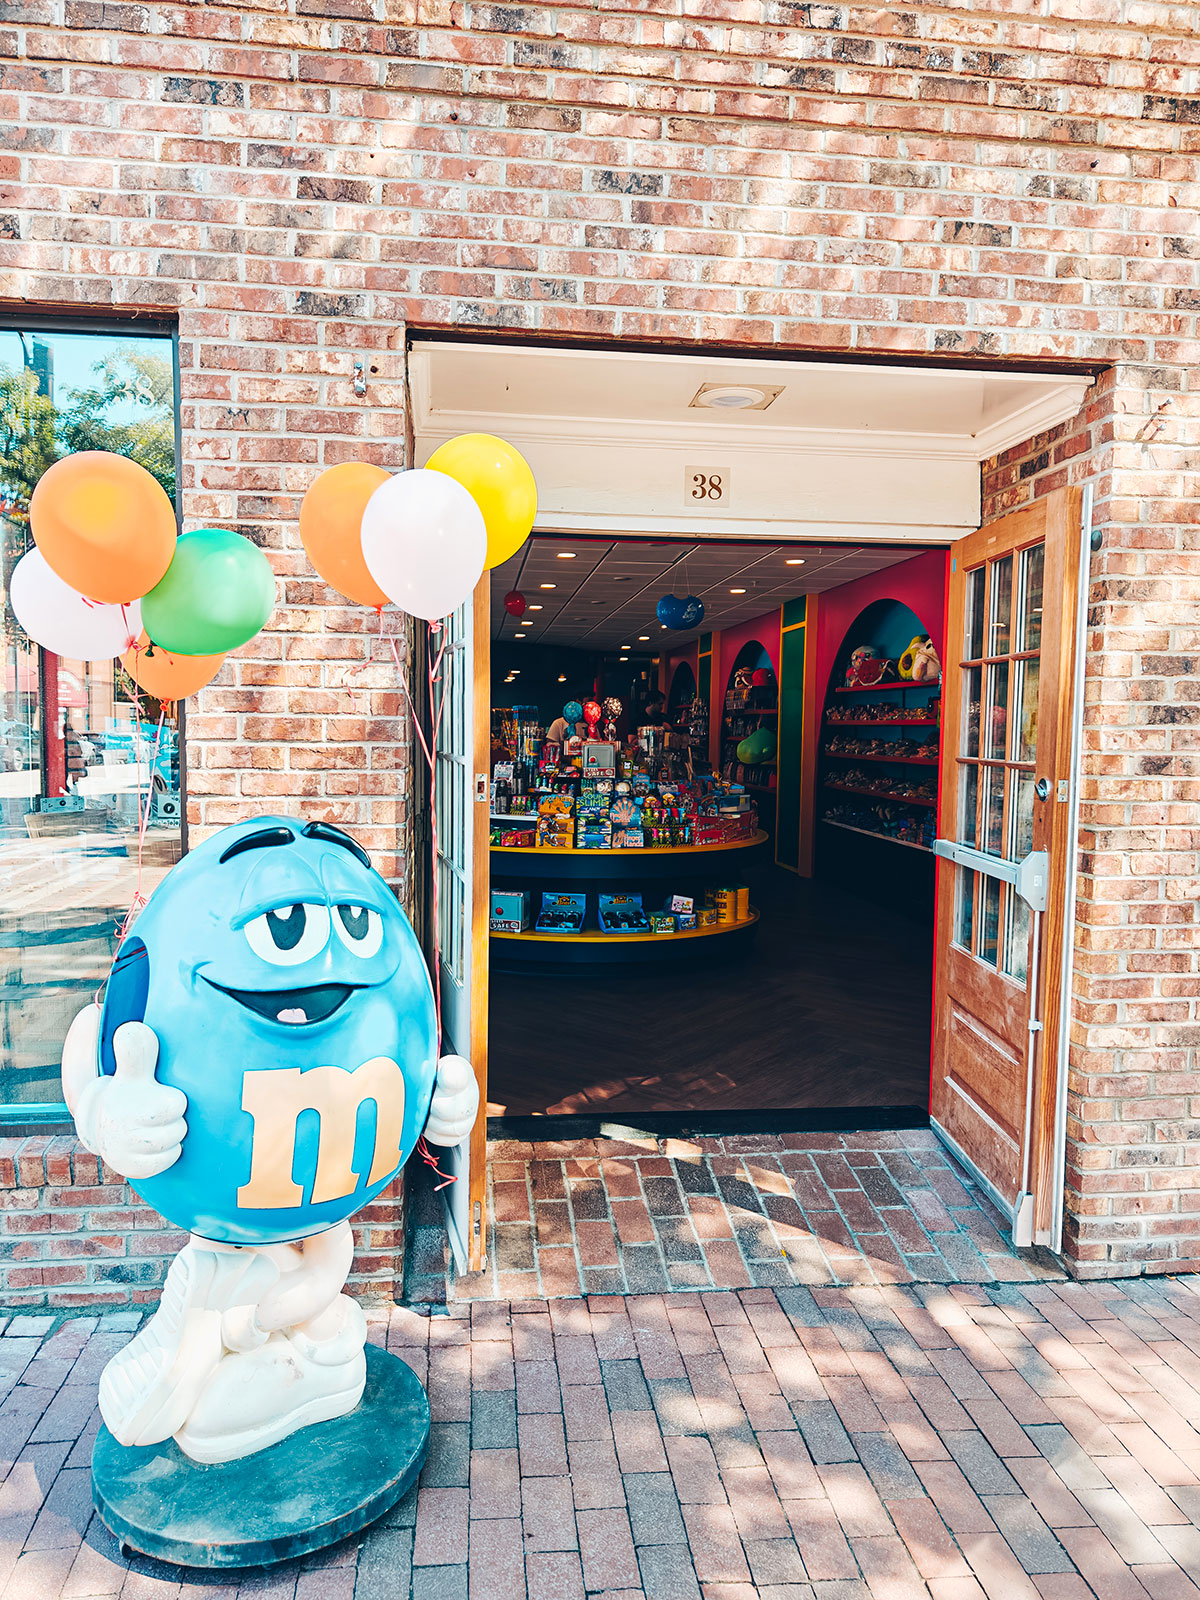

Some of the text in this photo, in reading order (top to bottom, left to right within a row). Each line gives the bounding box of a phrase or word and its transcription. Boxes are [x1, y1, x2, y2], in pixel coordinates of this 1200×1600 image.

[691, 473, 722, 501] 38
[579, 799, 607, 807] SLIME
[583, 791, 603, 800] SOUR
[237, 1055, 406, 1210] m
